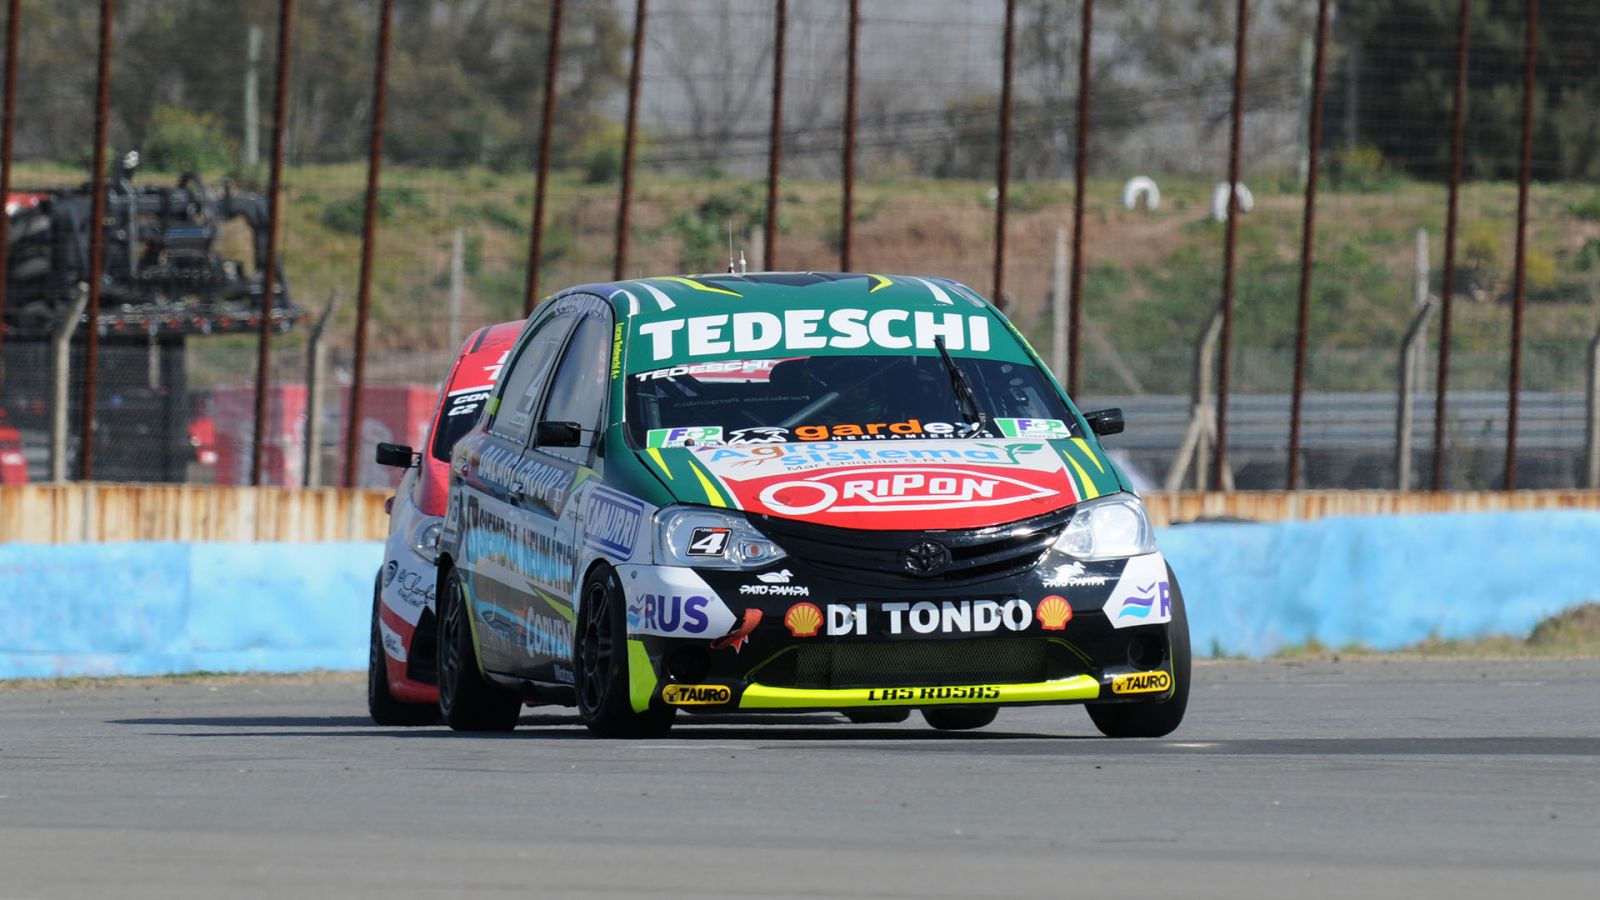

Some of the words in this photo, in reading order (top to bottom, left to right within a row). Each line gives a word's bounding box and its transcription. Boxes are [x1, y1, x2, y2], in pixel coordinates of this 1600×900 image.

[639, 309, 990, 361] TEDESCHI
[636, 360, 771, 382] TEDESCHI
[447, 403, 478, 416] C2
[795, 418, 989, 441] gardex
[831, 433, 994, 441] HERRAMIENTS
[710, 443, 839, 465] Agro
[780, 449, 999, 467] sistema
[691, 533, 725, 554] 4
[644, 594, 709, 633] RUS
[827, 603, 867, 636] DI
[882, 598, 1032, 634] TONDO
[526, 606, 573, 661] CORVEN
[868, 687, 914, 701] LAS
[919, 686, 1000, 700] ROSAS
[1126, 676, 1168, 690] TAURO
[679, 688, 729, 702] TAURO
